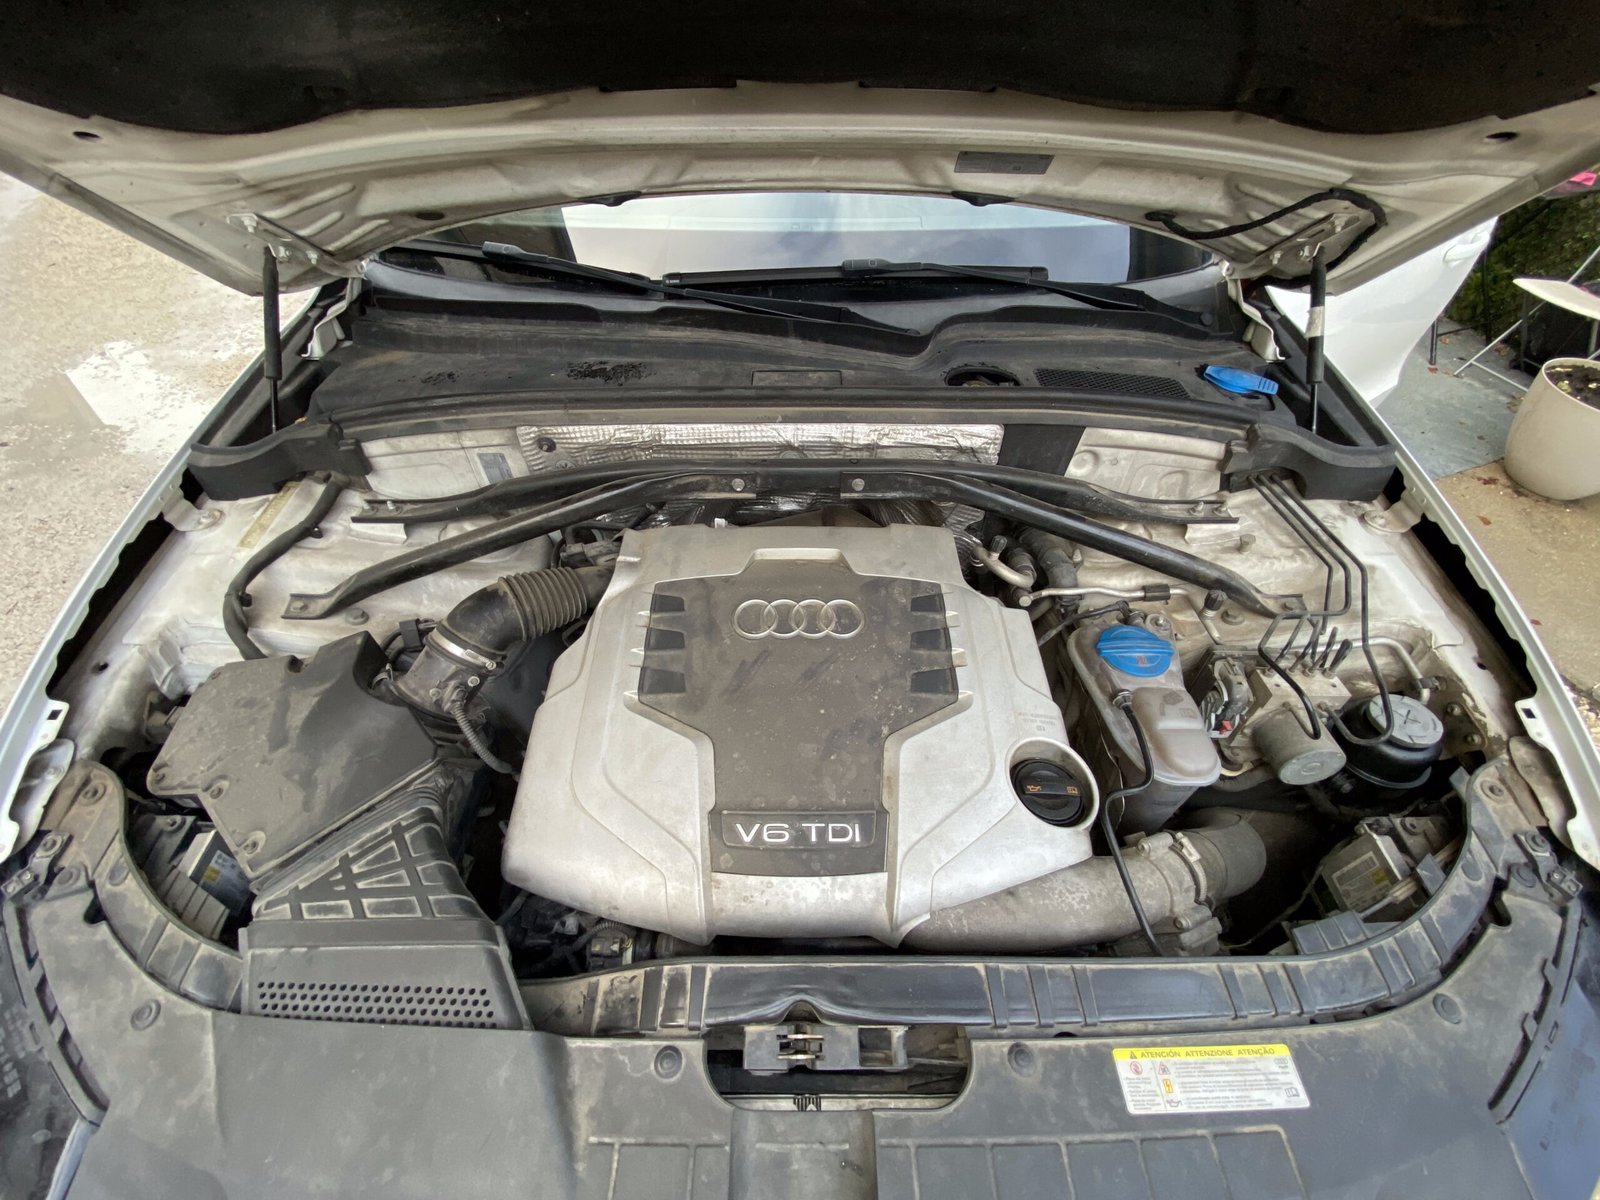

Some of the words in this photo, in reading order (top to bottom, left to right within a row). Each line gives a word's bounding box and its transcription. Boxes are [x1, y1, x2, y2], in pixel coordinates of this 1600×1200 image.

[735, 823, 790, 843] V6
[801, 823, 861, 843] TDI
[1140, 1049, 1181, 1058] ATENCIÓN
[1185, 1049, 1233, 1057] ATTENZIONE
[1237, 1047, 1275, 1056] ATENÇÃO
